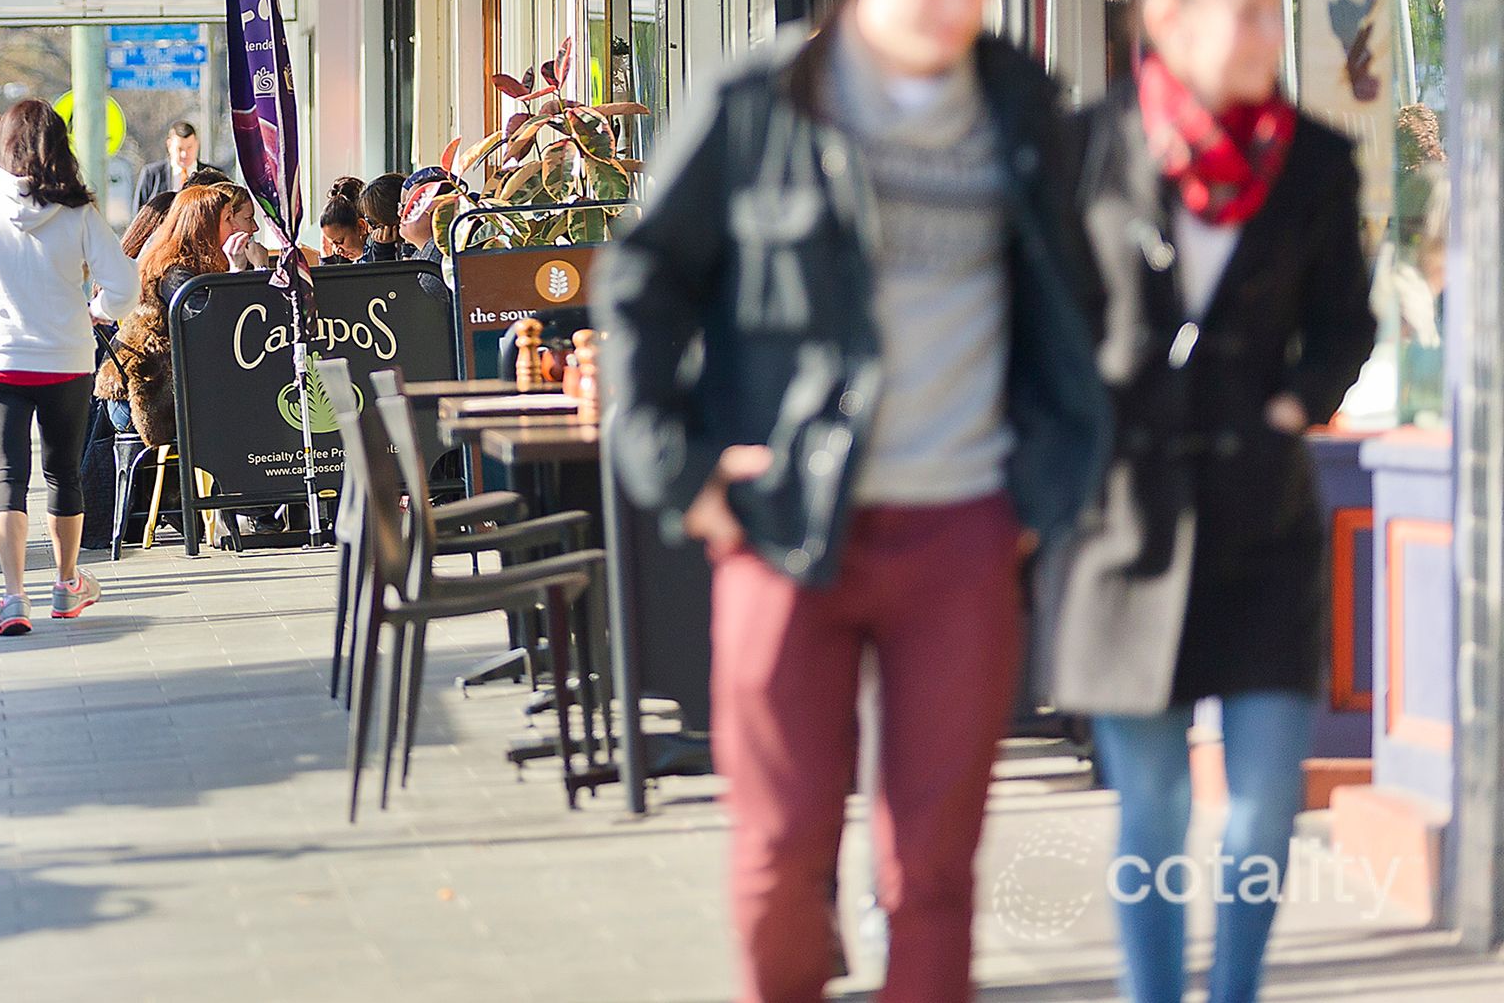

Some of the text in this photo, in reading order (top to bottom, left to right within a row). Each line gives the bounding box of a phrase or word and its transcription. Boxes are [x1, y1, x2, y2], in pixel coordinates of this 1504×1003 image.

[469, 307, 497, 324] the
[247, 449, 294, 466] Specialty
[296, 448, 329, 461] Cfee
